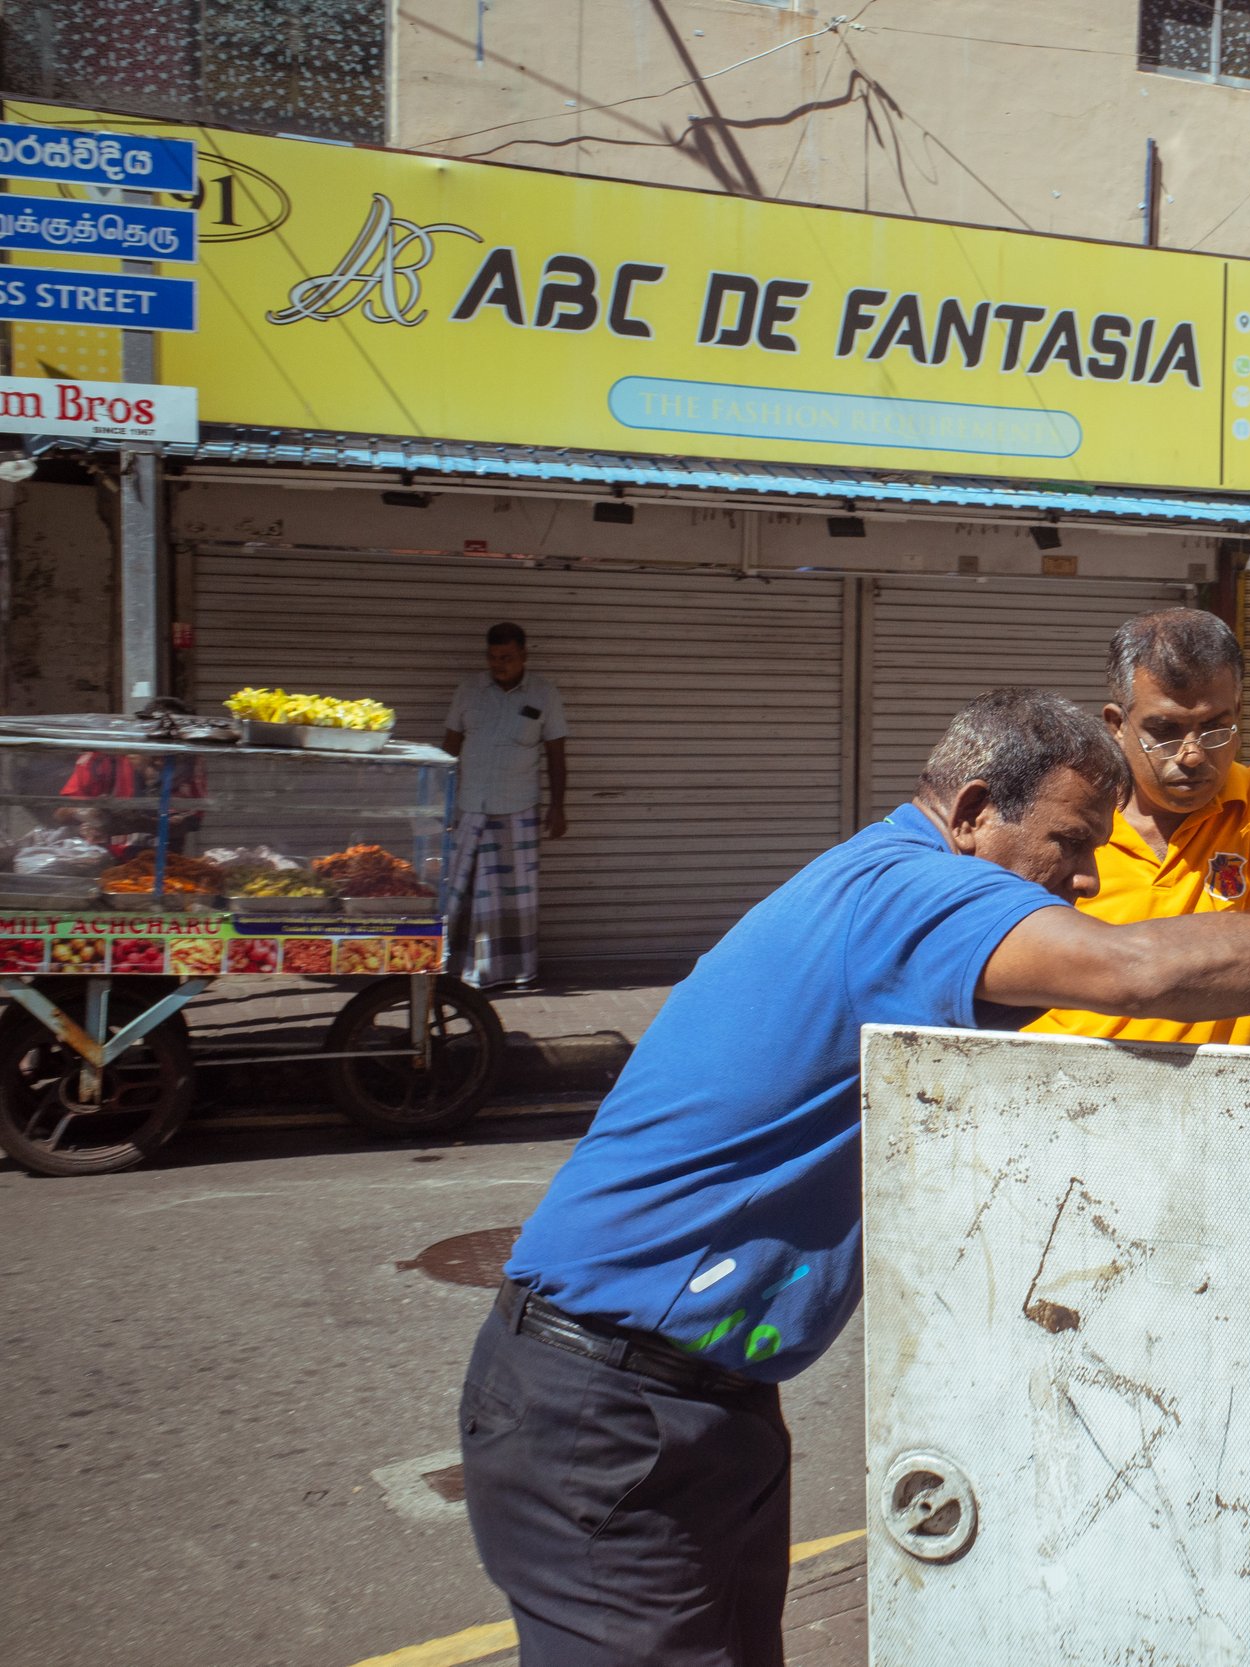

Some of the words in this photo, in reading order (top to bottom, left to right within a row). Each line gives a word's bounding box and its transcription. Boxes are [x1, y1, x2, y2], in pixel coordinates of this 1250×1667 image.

[36, 284, 157, 314] STREET
[448, 246, 666, 340] ABC
[696, 270, 811, 353] DE
[835, 288, 1202, 389] FANTASIA
[55, 384, 155, 425] Bros
[640, 391, 700, 419] THE
[711, 396, 840, 430] FASHION
[92, 426, 127, 435] SINCE
[71, 916, 222, 935] ACHCHARU
